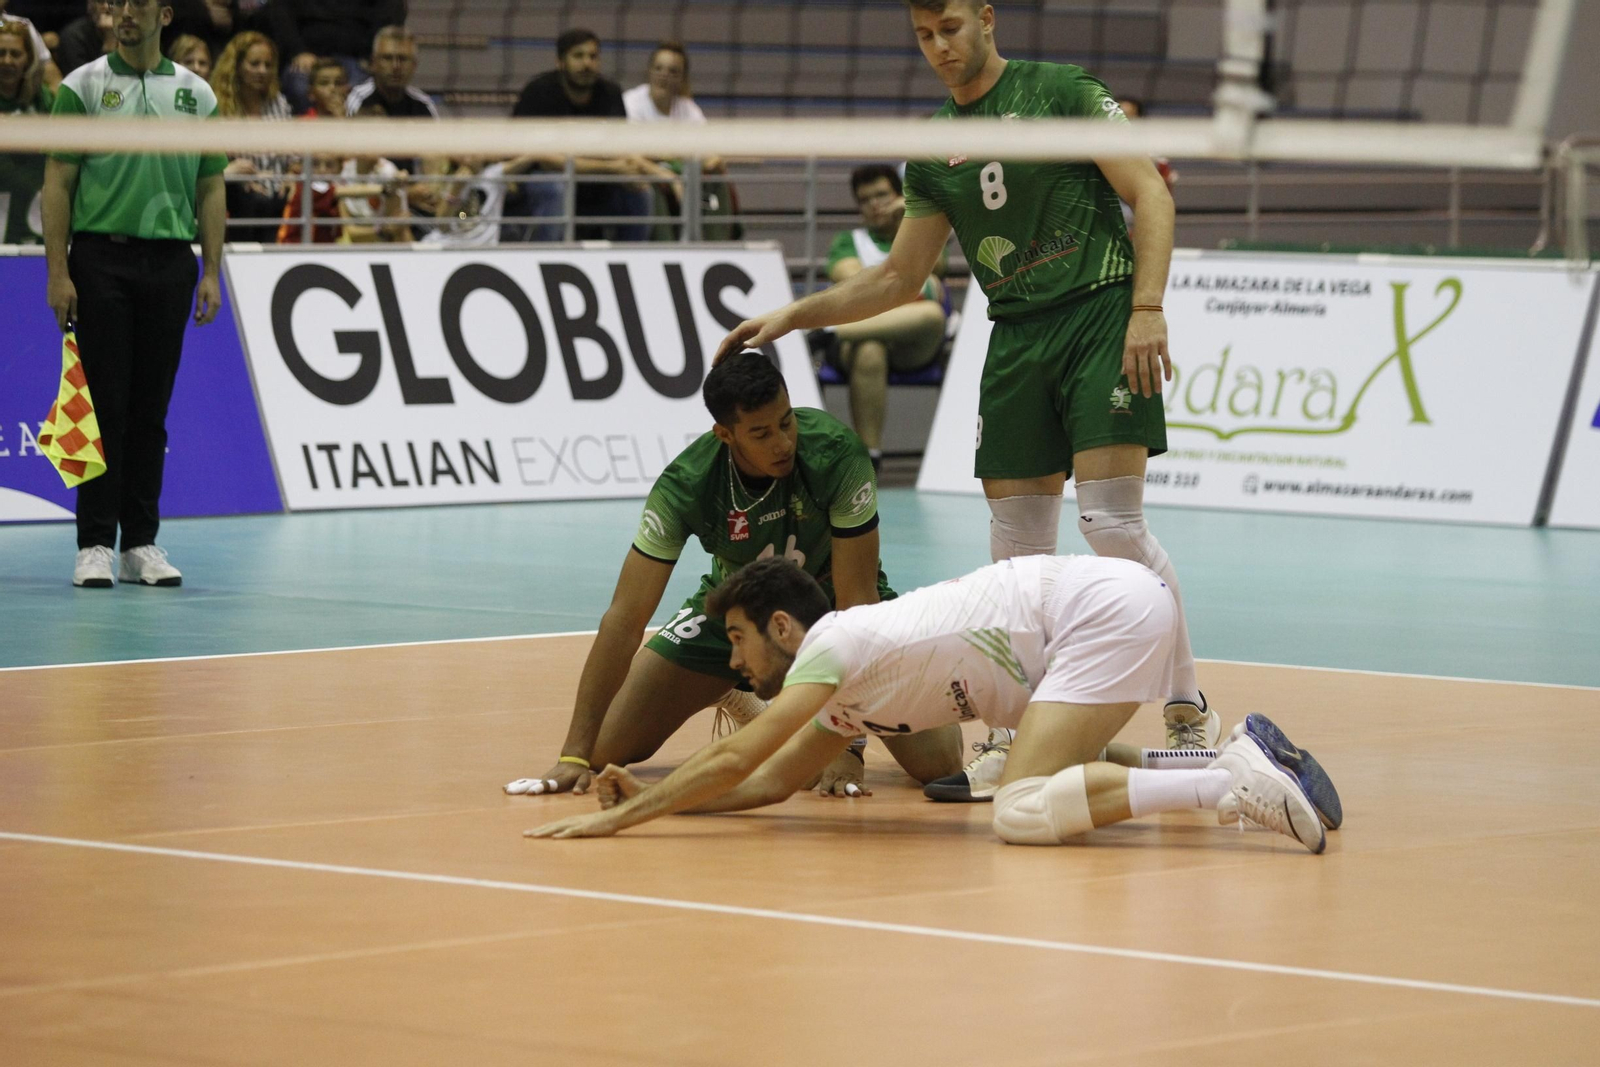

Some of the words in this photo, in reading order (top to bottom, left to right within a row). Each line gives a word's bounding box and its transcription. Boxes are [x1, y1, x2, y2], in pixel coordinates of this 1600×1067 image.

[979, 161, 1008, 210] 8
[1172, 274, 1191, 290] LA
[1306, 279, 1326, 296] LA
[1330, 280, 1372, 298] VEGA
[271, 263, 782, 405] GLOBUS
[301, 440, 500, 490] ITALIAN
[665, 607, 707, 639] 16
